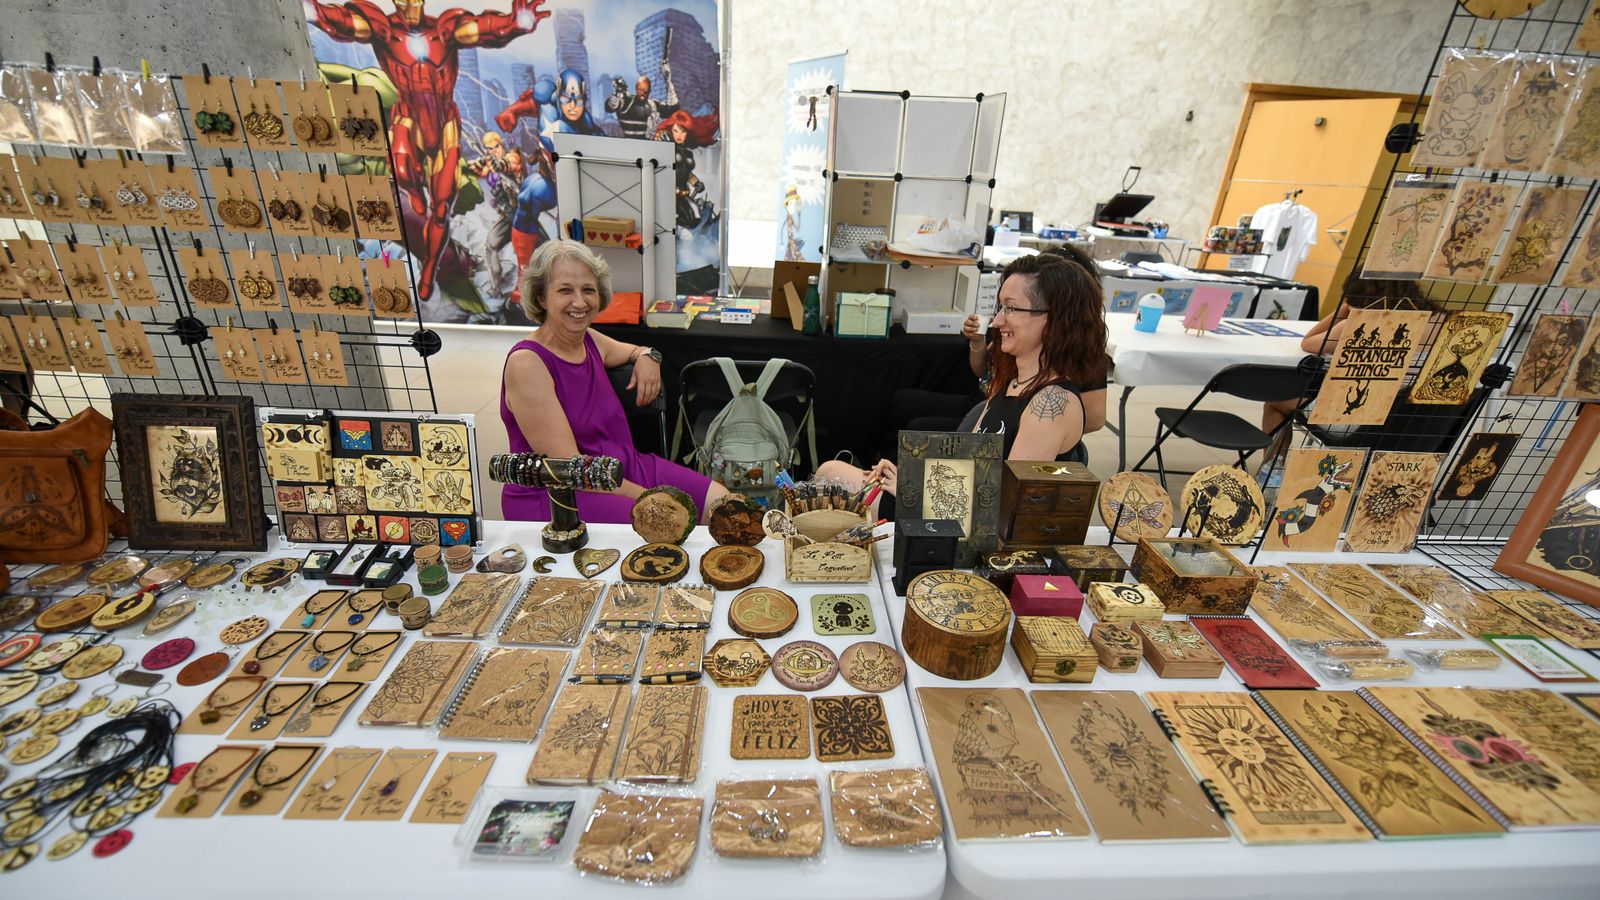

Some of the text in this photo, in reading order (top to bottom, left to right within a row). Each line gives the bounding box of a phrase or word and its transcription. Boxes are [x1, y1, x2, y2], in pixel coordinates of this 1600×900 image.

[1338, 350, 1408, 366] STRANGER
[1345, 364, 1391, 377] THINGS
[1388, 462, 1422, 472] STARK
[802, 549, 820, 560] Le
[920, 573, 957, 588] GUNS
[941, 614, 999, 631] ROSES
[751, 700, 780, 713] HOY
[743, 735, 799, 750] FELIZ
